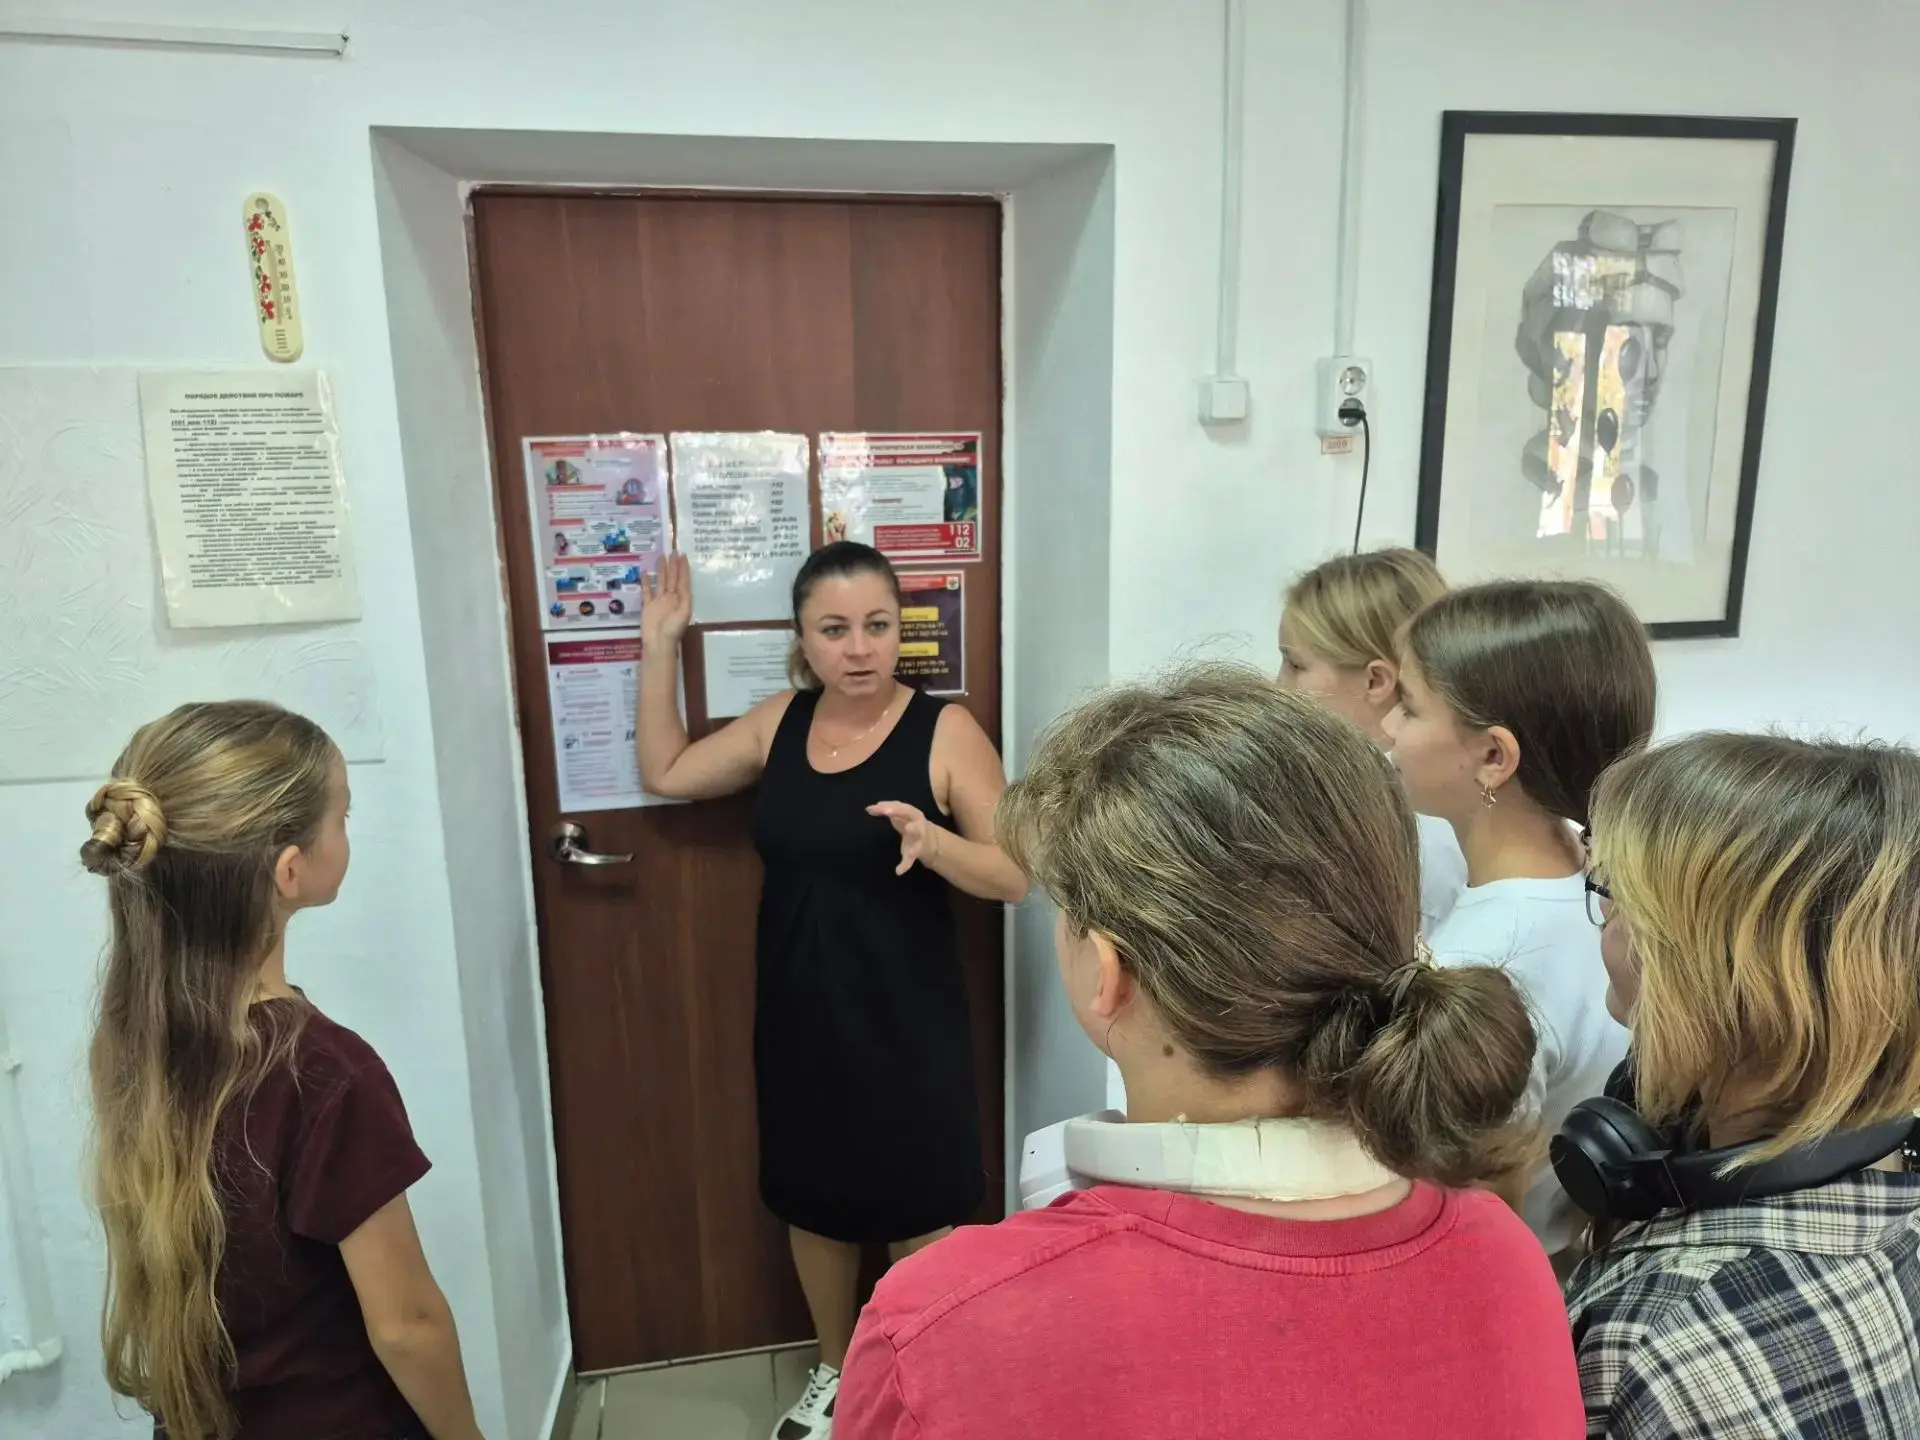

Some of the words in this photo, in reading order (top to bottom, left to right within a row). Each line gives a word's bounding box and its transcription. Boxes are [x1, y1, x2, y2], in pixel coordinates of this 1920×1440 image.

[274, 391, 304, 399] ПОЖАРЕ
[949, 524, 970, 536] 112
[955, 536, 970, 548] 02
